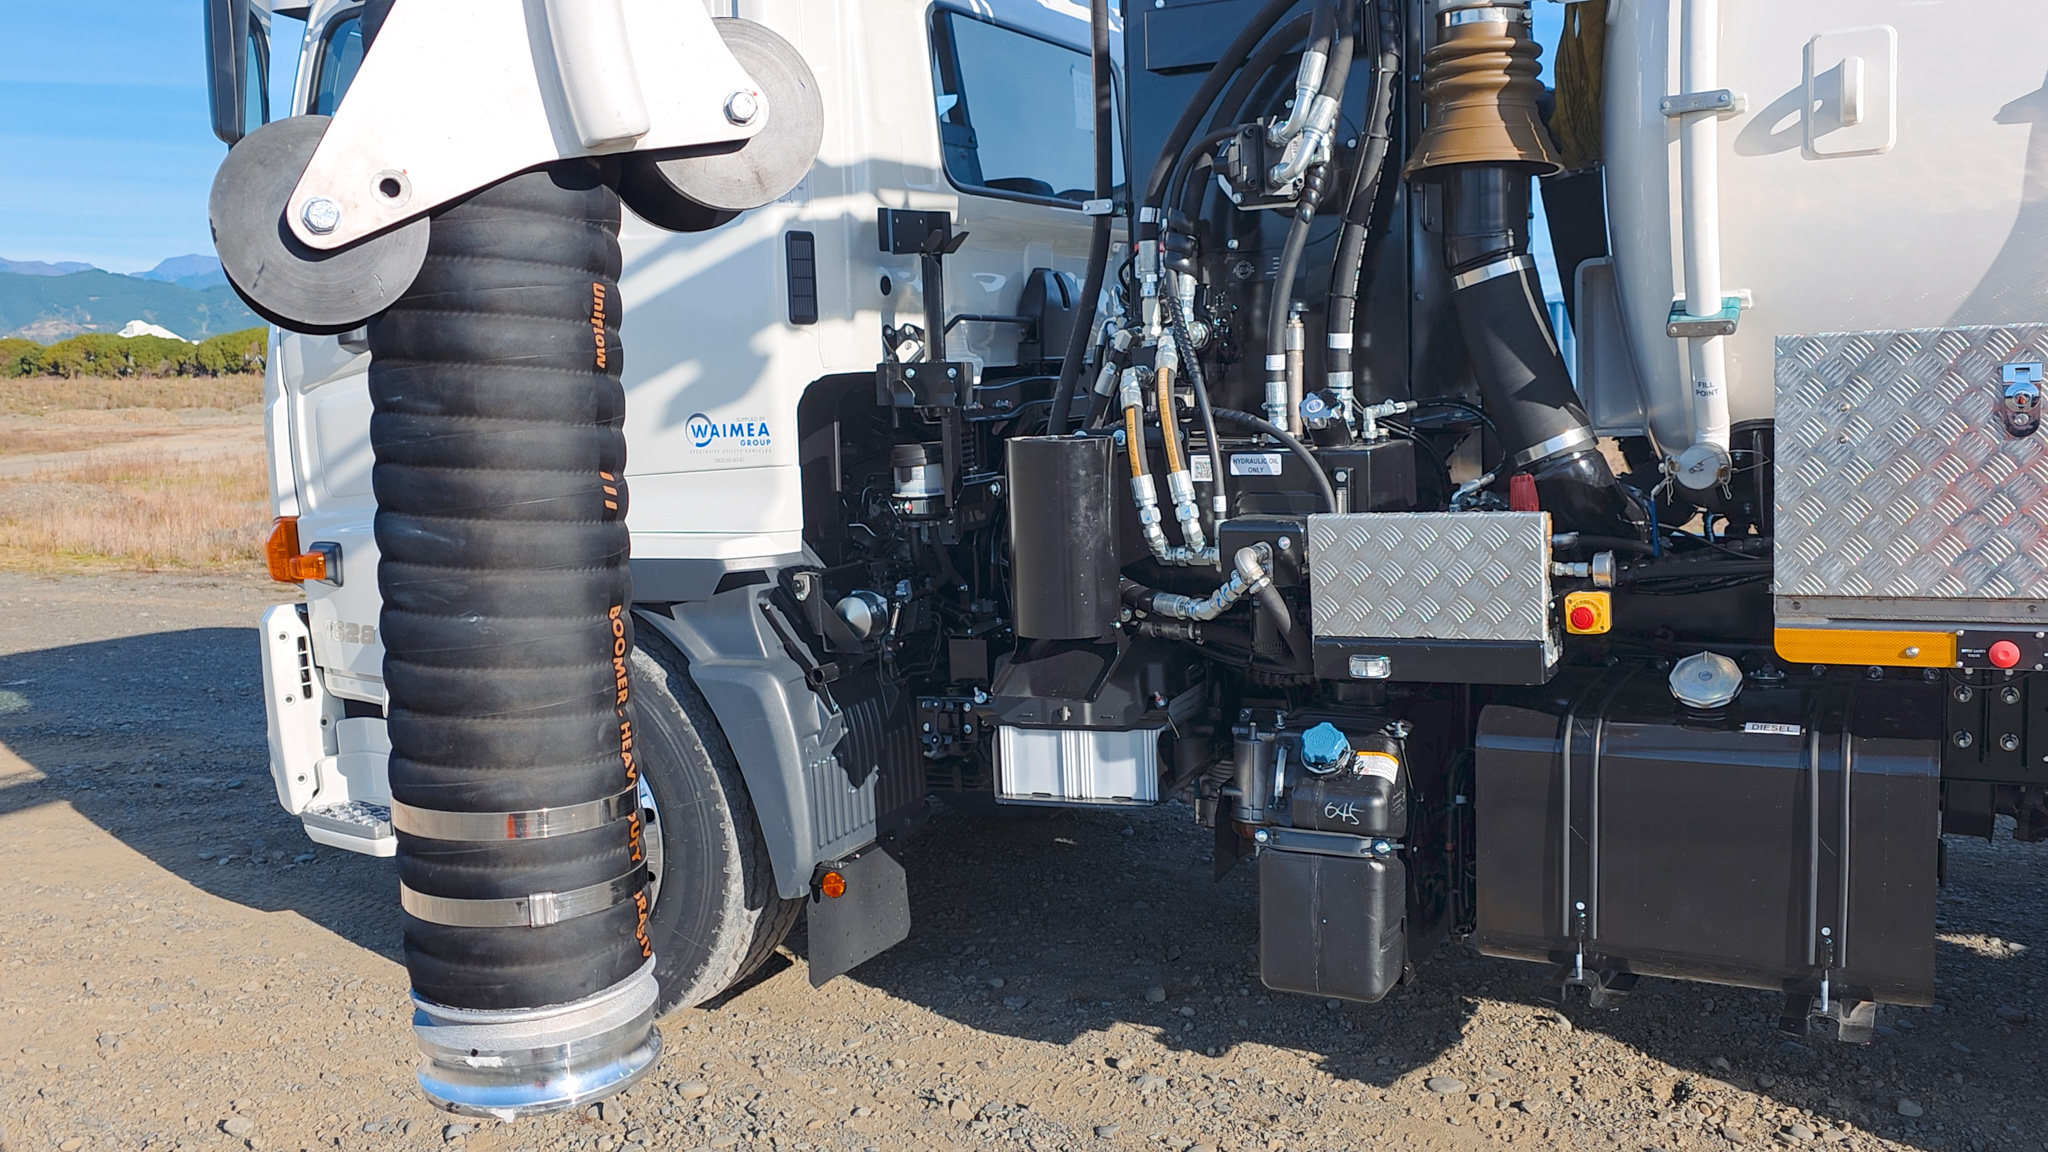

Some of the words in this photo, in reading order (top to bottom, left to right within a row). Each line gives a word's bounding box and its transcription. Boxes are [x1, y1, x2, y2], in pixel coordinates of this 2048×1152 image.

[591, 282, 606, 369] Uniflow
[690, 422, 770, 438] WAIMEA
[325, 620, 375, 645] 1628
[609, 604, 628, 704] BOOMER
[1751, 723, 1793, 732] DIESEL
[1324, 801, 1365, 825] 645
